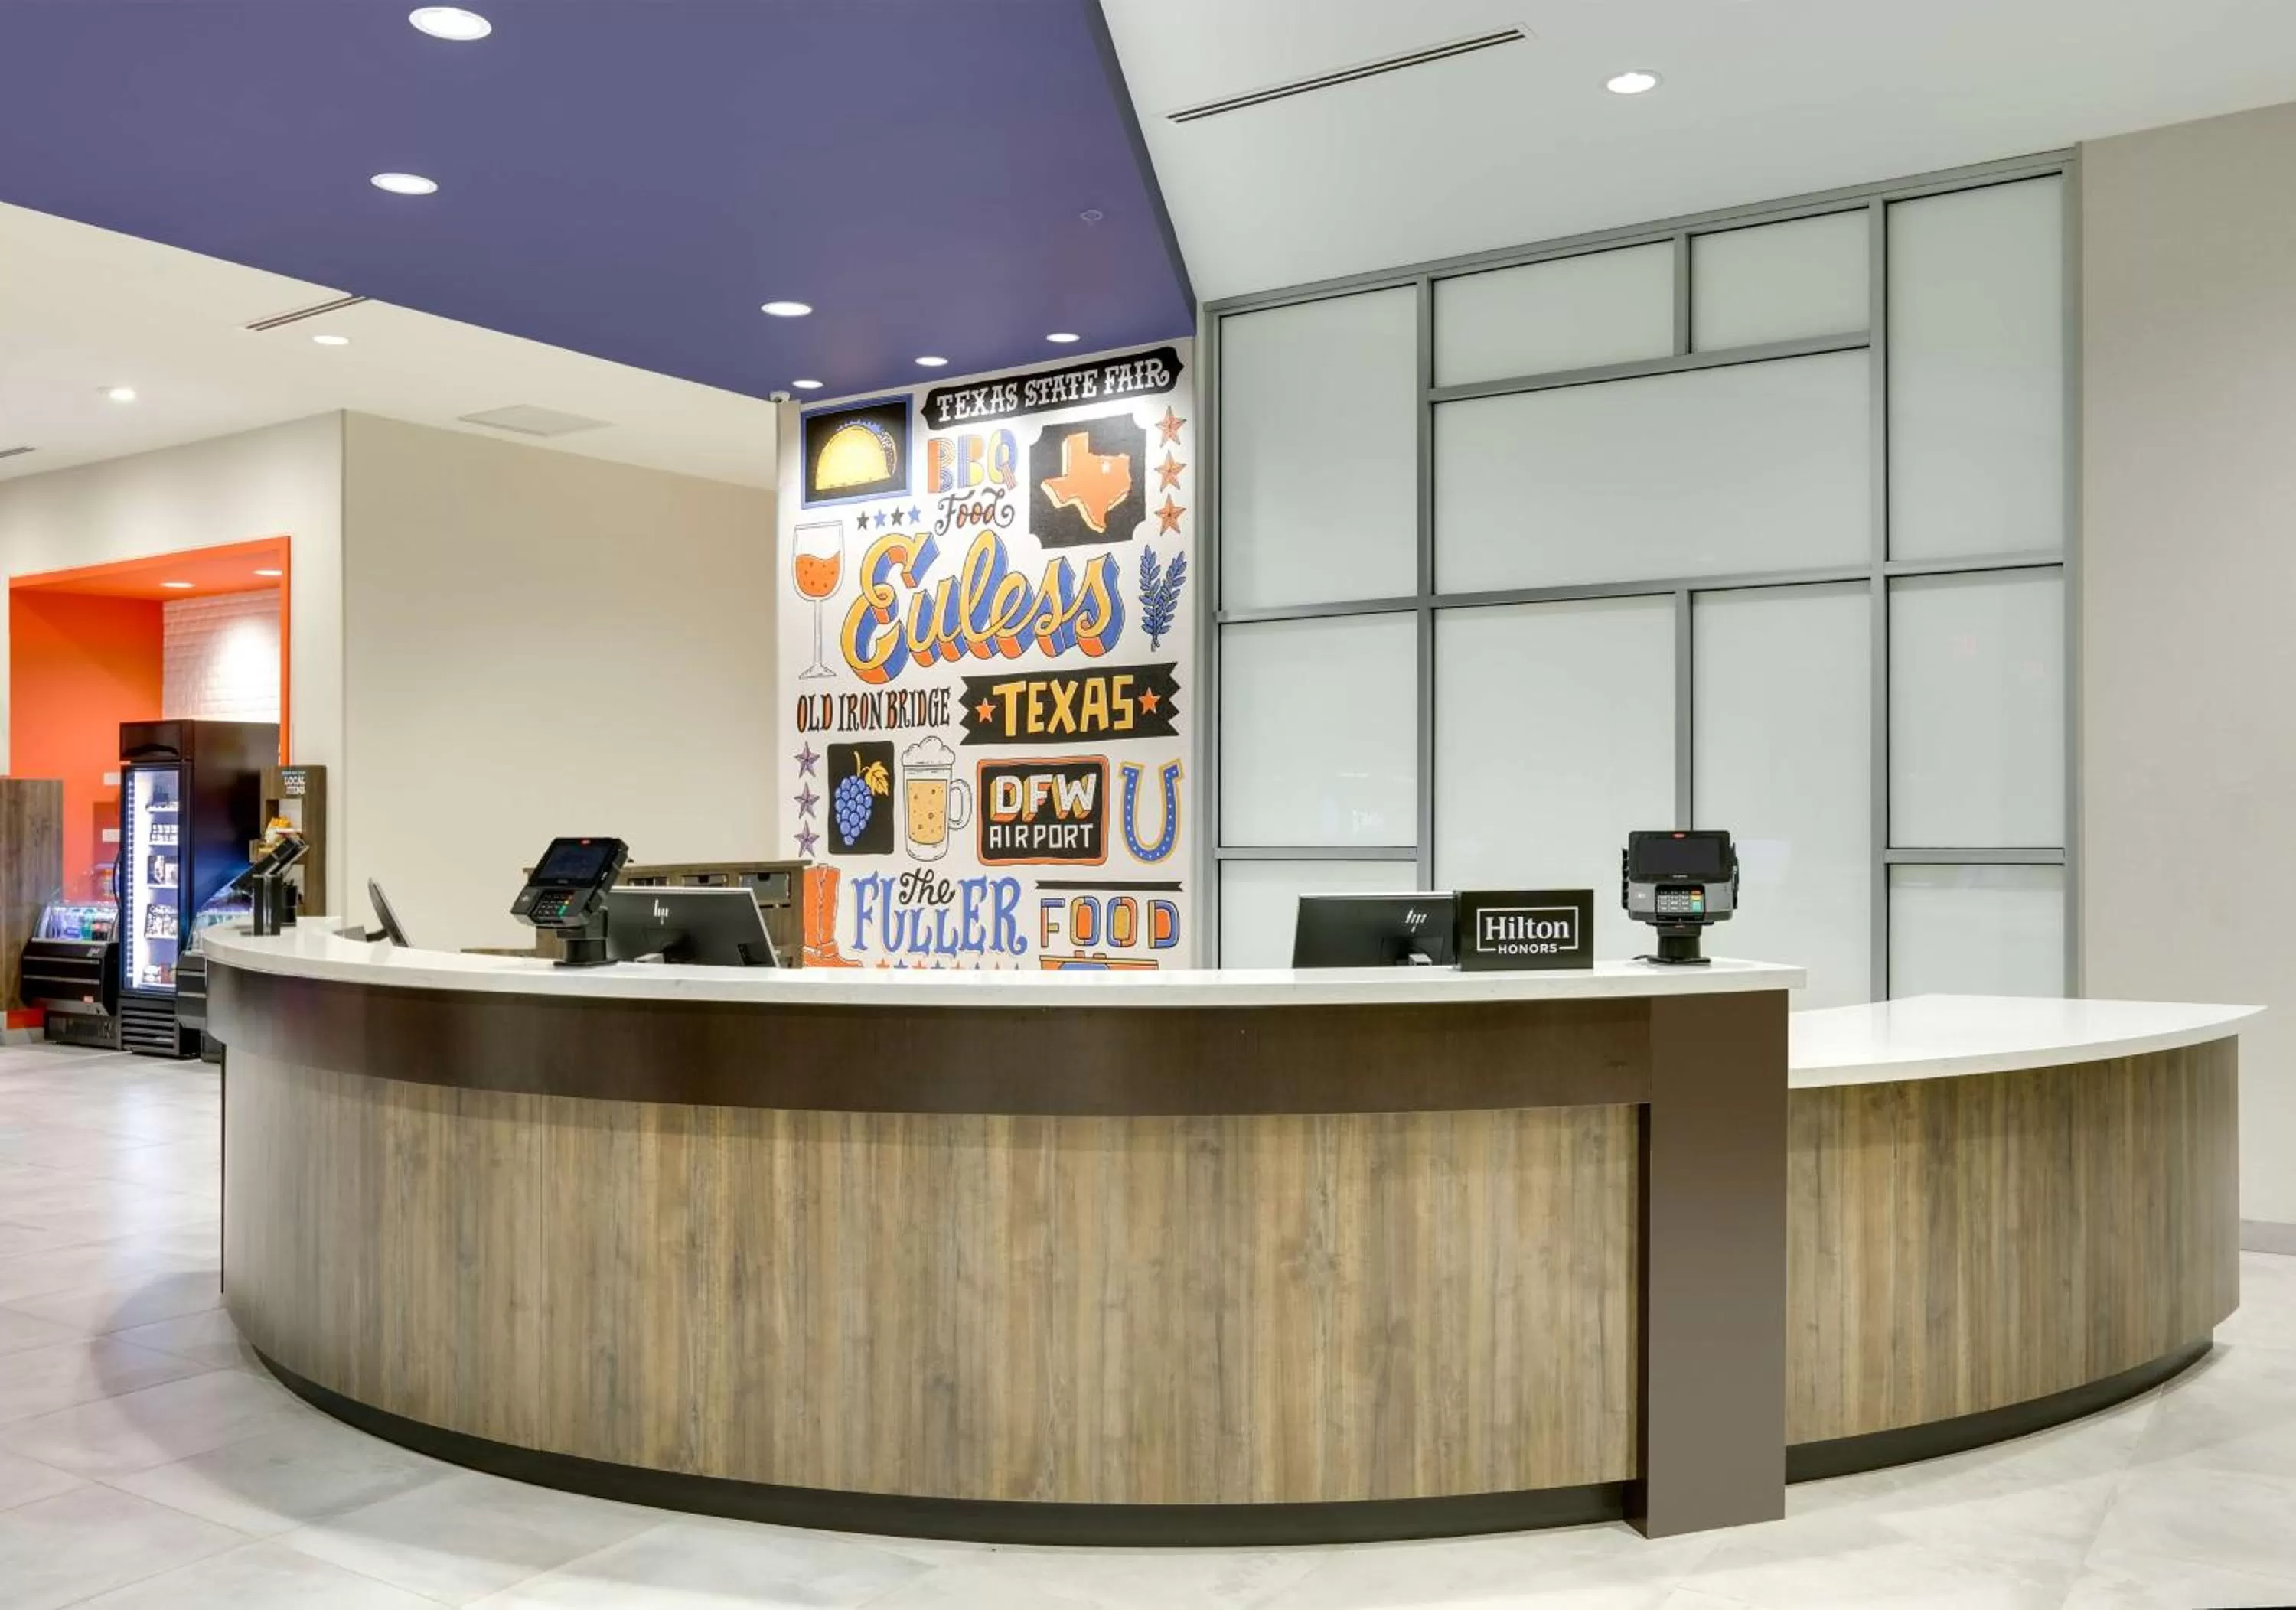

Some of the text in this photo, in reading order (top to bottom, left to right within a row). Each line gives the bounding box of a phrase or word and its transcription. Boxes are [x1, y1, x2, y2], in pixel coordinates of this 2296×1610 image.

[937, 358, 1170, 422] TEXAS STATE FAIR
[927, 429, 1019, 494] BBQ
[935, 487, 1014, 536] Food
[840, 529, 1125, 684] Euless
[797, 686, 951, 733] OLD IRON BRIDGE
[993, 674, 1133, 737] TEXAS
[990, 773, 1097, 823] DFW
[990, 823, 1093, 849] AIRPORT
[899, 868, 955, 905] The
[654, 898, 670, 926] hp
[850, 869, 1028, 958] FULLER
[1041, 896, 1181, 950] FOOD
[1405, 908, 1427, 933] hp
[1485, 916, 1570, 940] Hilton
[1498, 944, 1557, 954] HONORS
